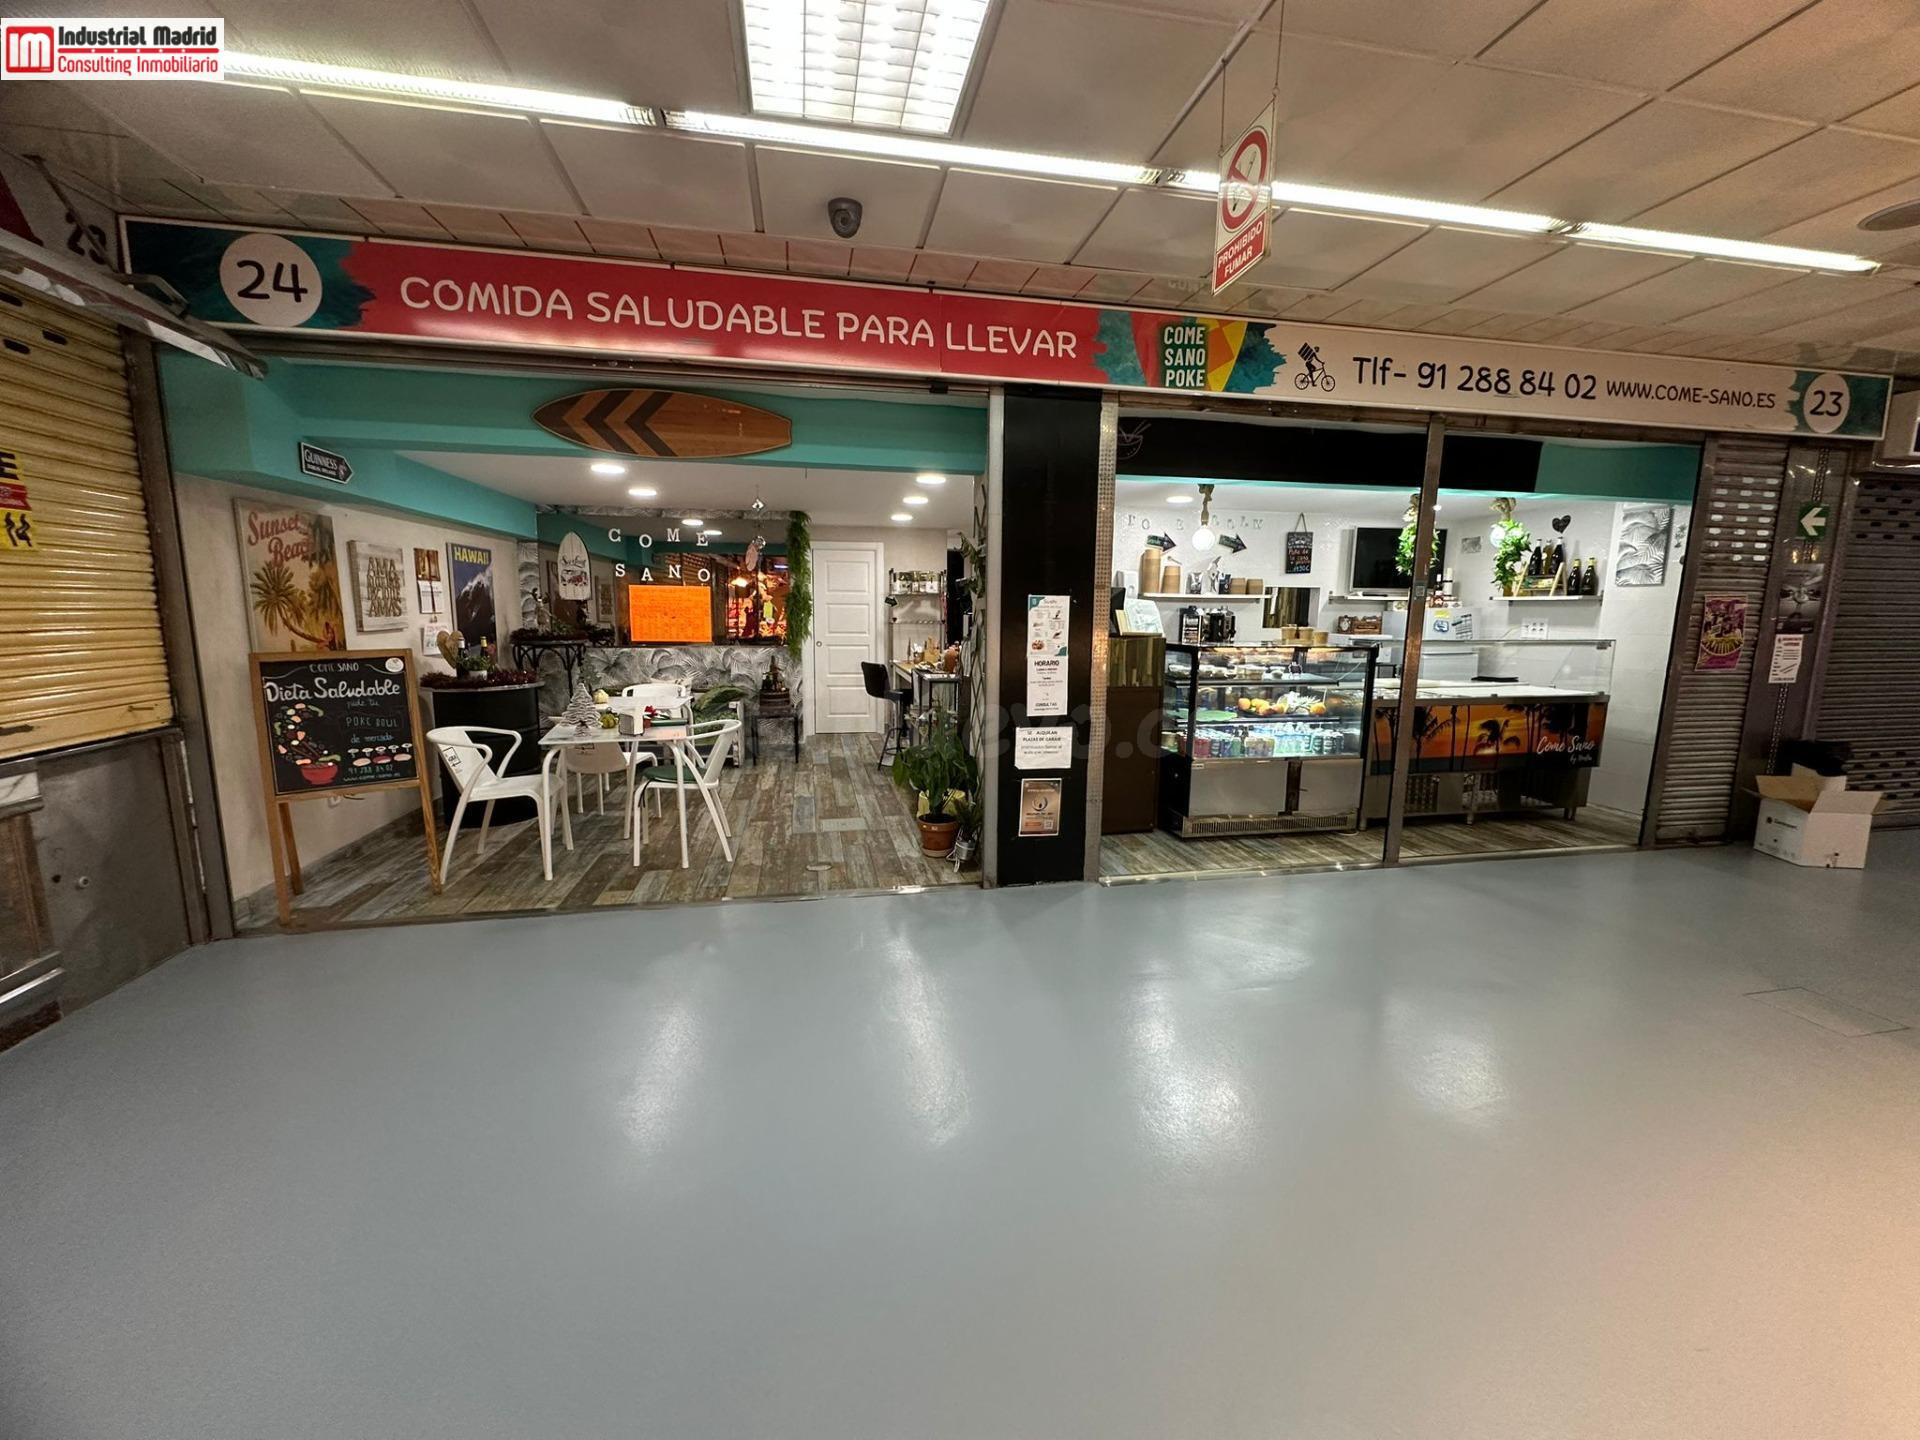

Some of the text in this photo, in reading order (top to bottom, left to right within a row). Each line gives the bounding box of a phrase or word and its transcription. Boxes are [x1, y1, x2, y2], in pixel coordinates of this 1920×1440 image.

[1218, 221, 1262, 268] PROHIBIDO
[1224, 245, 1253, 278] FUMAR
[236, 260, 308, 303] 24
[400, 276, 1077, 359] COMIDA SALUDABLE PARA LLEVAR
[1163, 326, 1205, 345] COME
[1164, 348, 1206, 367] SANO
[1165, 369, 1205, 387] POKE
[1417, 362, 1447, 390] 91
[1457, 365, 1511, 395] 288
[1519, 369, 1555, 397] 84
[1564, 373, 1597, 400] 02
[1606, 380, 1776, 409] WWW.COME-SANO.ES
[1809, 390, 1843, 417] 23
[248, 511, 301, 546] Sunset
[608, 528, 709, 547] COME
[453, 546, 489, 565] HAWAII
[615, 563, 711, 582] SANO
[337, 662, 359, 672] SANO
[263, 677, 401, 702] Dieta Saludable
[1537, 735, 1595, 754] Come Sano
